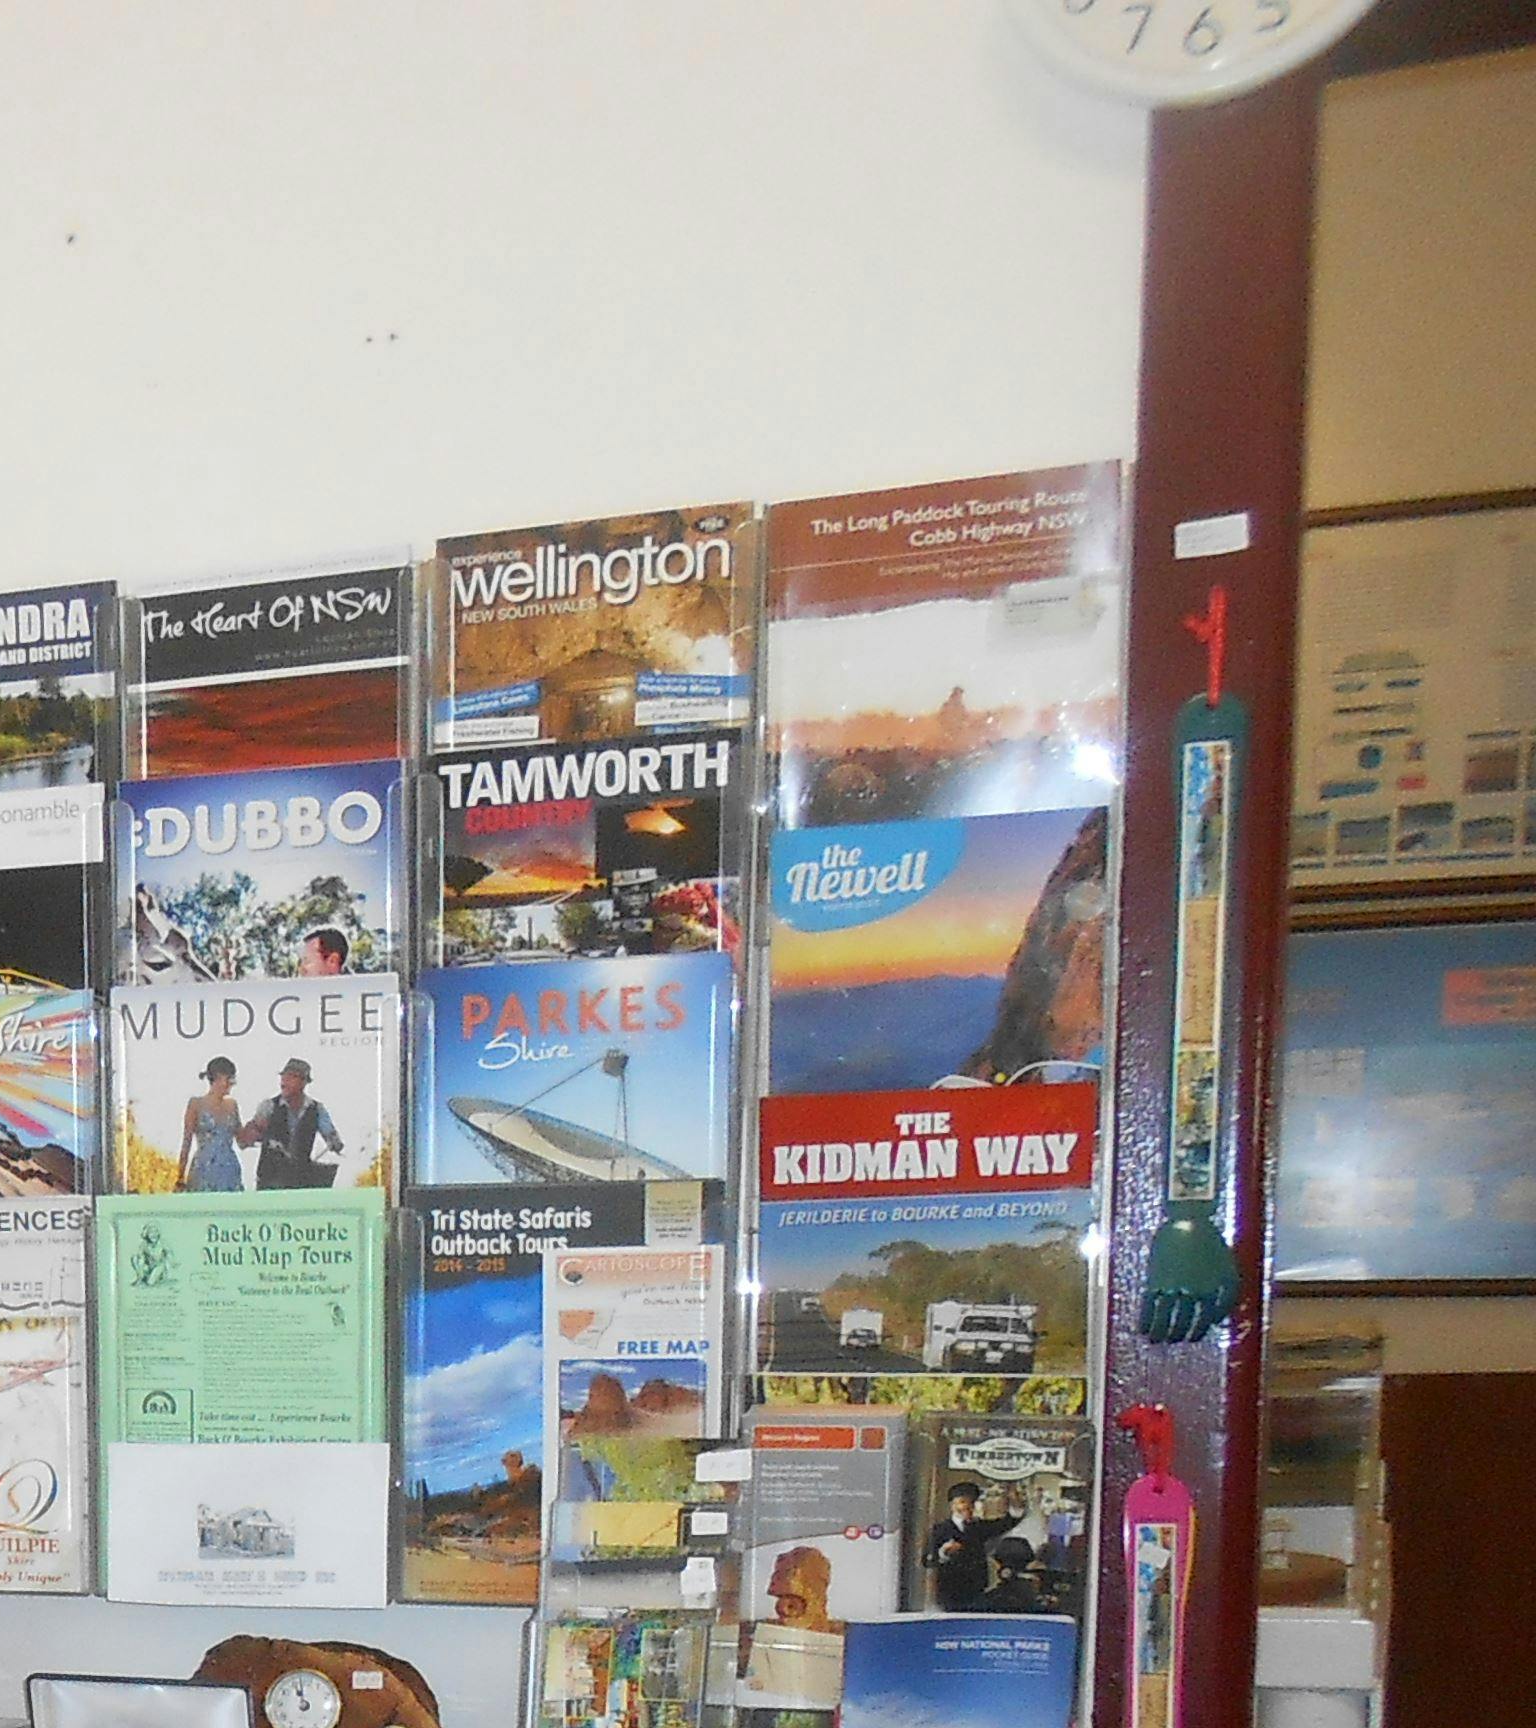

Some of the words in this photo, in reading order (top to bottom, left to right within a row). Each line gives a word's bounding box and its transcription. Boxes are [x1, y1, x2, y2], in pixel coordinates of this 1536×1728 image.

[1124, 6, 1151, 54] 7
[1184, 8, 1221, 55] 6
[811, 519, 842, 535] The
[848, 515, 888, 532] Long
[893, 506, 964, 525] Paddock
[966, 497, 1028, 518] Touring
[910, 530, 957, 547] Cobb
[962, 522, 1032, 543] Highway
[452, 550, 521, 567] experience
[452, 536, 730, 607] wellington
[145, 611, 183, 642] The
[190, 602, 264, 638] Heart
[269, 595, 303, 632] Of
[310, 587, 391, 623] NSW
[462, 611, 492, 625] NEW
[499, 605, 546, 621] SOUTH
[549, 598, 597, 614] WALES
[0, 650, 26, 667] AND
[29, 641, 92, 663] DISTRICT
[439, 740, 729, 809] TAMWORTH
[144, 791, 382, 857] DUBBO
[822, 845, 862, 868] the
[787, 851, 927, 902] Newell
[122, 993, 383, 1040] MUDGEE
[463, 983, 685, 1040] PARKES
[320, 1037, 384, 1047] REGION
[478, 1033, 575, 1070] Shire
[895, 1112, 951, 1135] THE
[774, 1139, 958, 1185] KIDMAN
[974, 1134, 1077, 1176] WAY
[431, 1210, 456, 1230] Tri
[460, 1209, 514, 1229] State
[519, 1206, 591, 1228] Safaris
[780, 1207, 867, 1227] JERILDERIE
[871, 1206, 885, 1221] to
[892, 1204, 959, 1221] BOURKE
[964, 1204, 993, 1218] and
[207, 1224, 252, 1243] Back
[431, 1235, 512, 1255] Outback
[517, 1233, 567, 1253] Tours
[203, 1246, 243, 1265] Mud
[250, 1246, 292, 1269] Map
[299, 1245, 353, 1264] Tours
[617, 1341, 659, 1354] FREE
[668, 1340, 709, 1354] MAP
